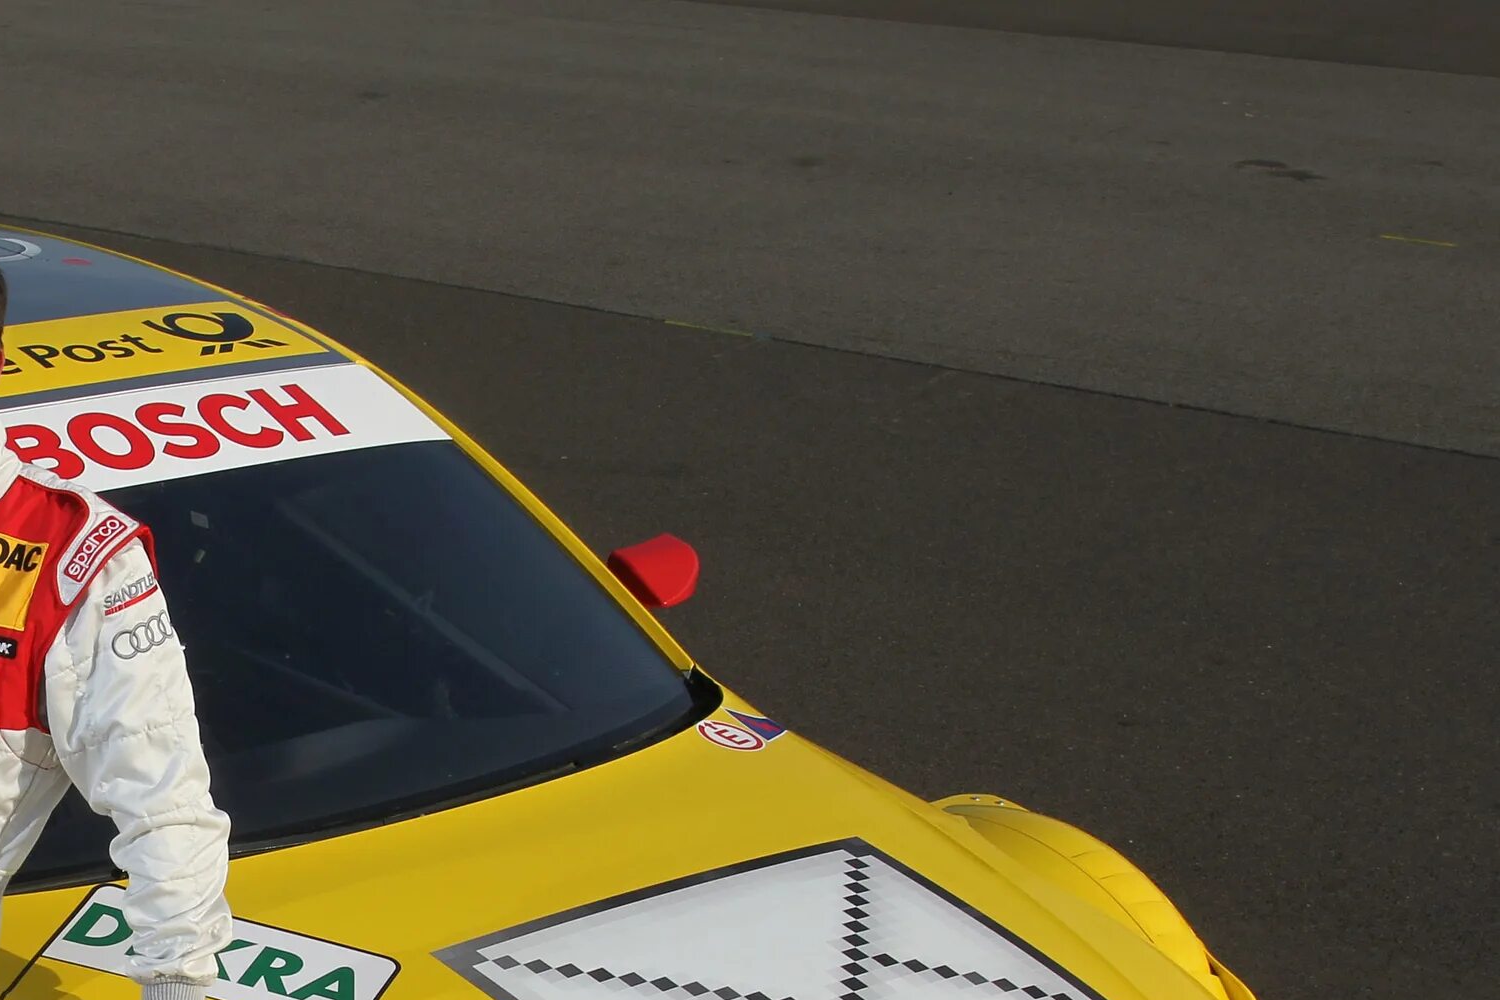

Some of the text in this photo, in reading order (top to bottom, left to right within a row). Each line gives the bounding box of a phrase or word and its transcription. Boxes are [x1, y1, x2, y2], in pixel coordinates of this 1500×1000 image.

[17, 332, 164, 369] Post
[5, 384, 351, 480] BOSCH
[68, 517, 122, 575] sparco
